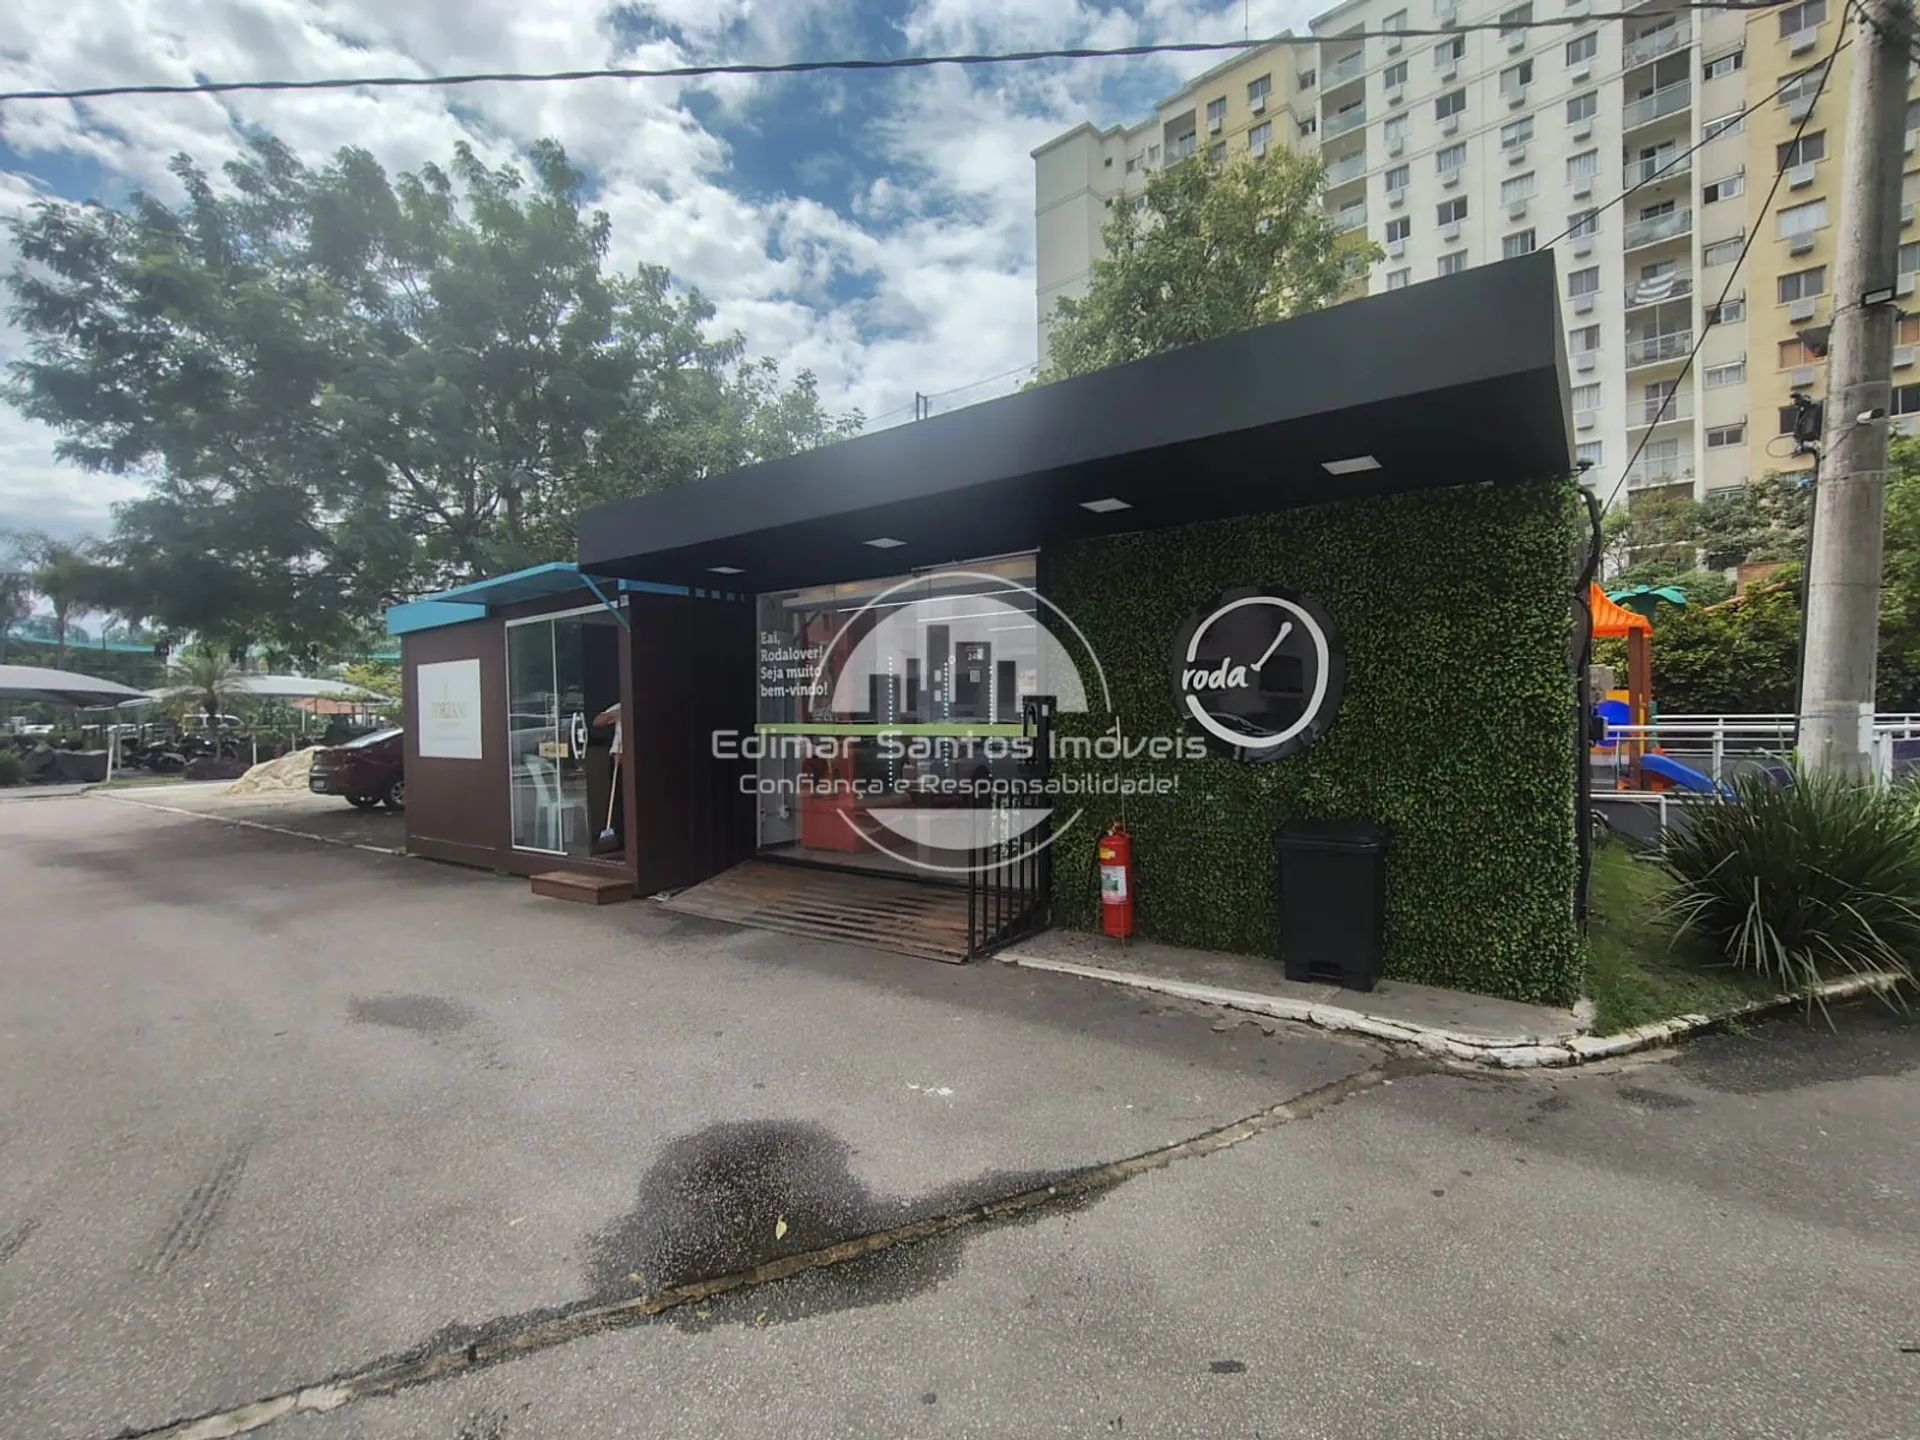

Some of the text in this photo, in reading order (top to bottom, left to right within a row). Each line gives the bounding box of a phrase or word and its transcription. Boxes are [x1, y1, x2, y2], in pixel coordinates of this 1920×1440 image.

[760, 645, 825, 662] Rodalover!
[760, 664, 822, 682] Seja muito
[1181, 656, 1249, 691] roda
[760, 681, 828, 697] bem-vindo!
